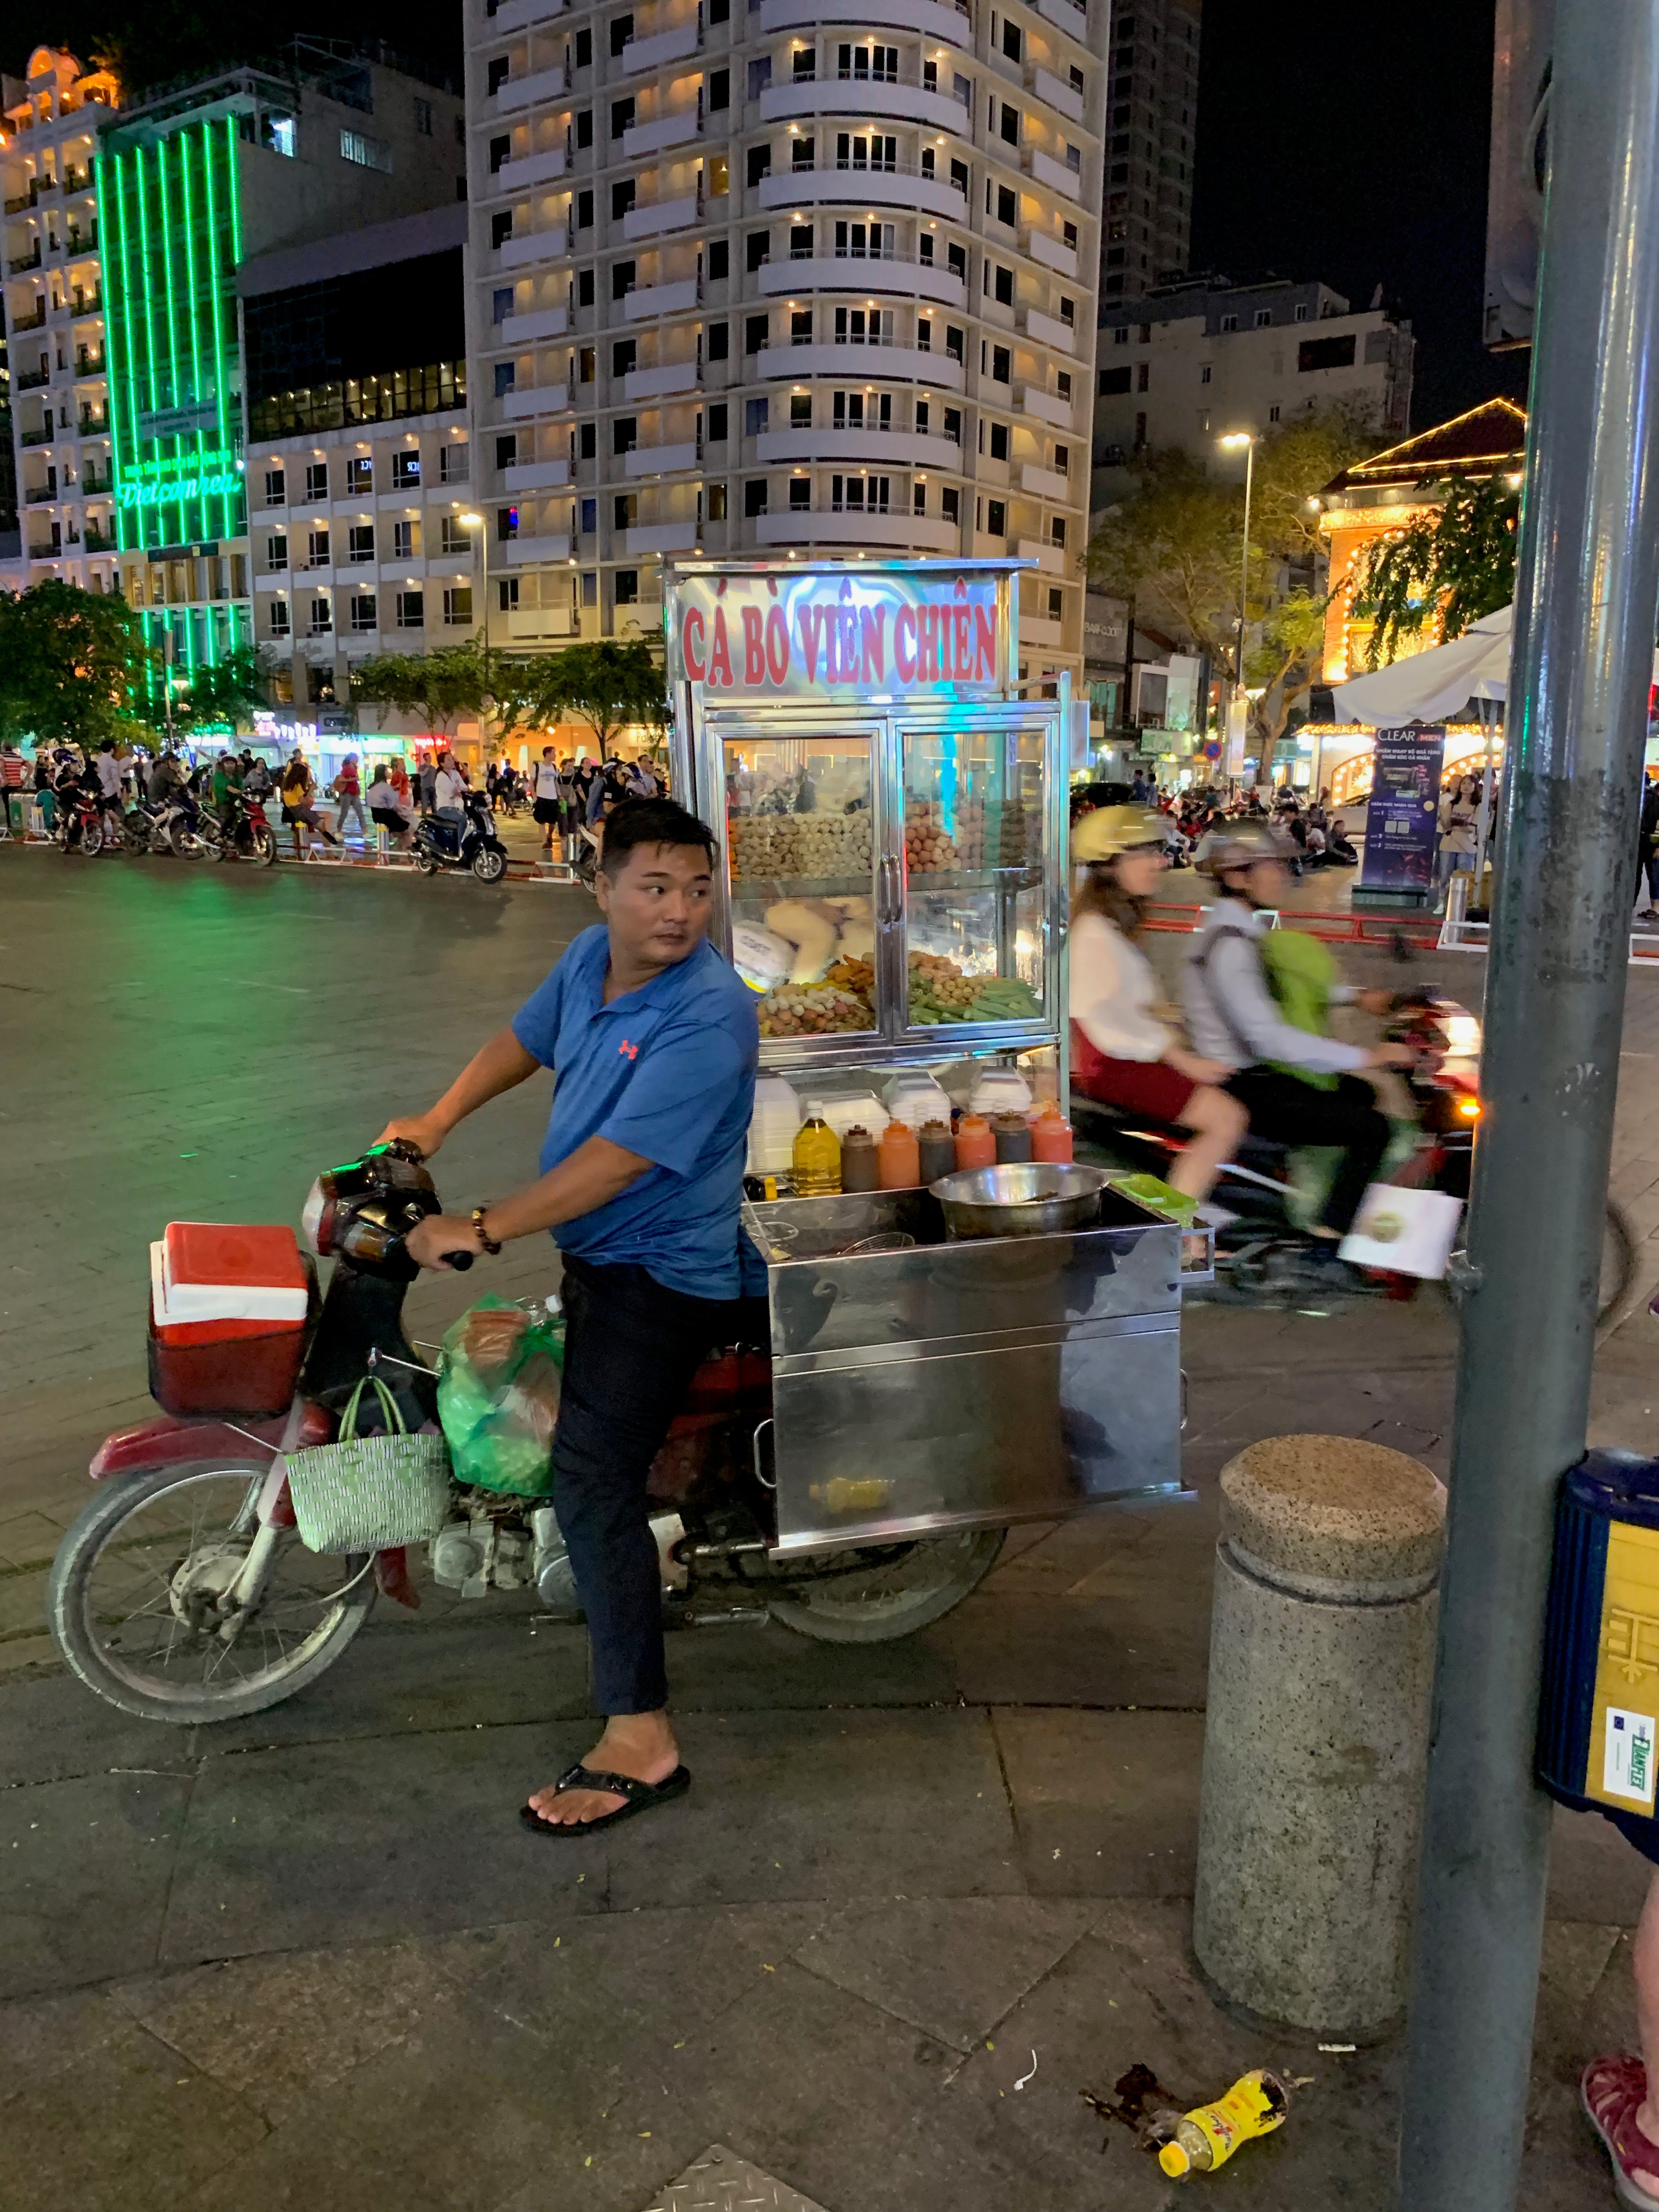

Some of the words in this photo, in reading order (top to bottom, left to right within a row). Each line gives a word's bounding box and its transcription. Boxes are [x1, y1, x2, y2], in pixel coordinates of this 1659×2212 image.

[682, 576, 733, 688] CÁ
[741, 576, 790, 687] BÒ
[797, 576, 886, 685] VIÊN
[893, 576, 998, 684] CHIÊN
[1377, 728, 1416, 741] CLEAR
